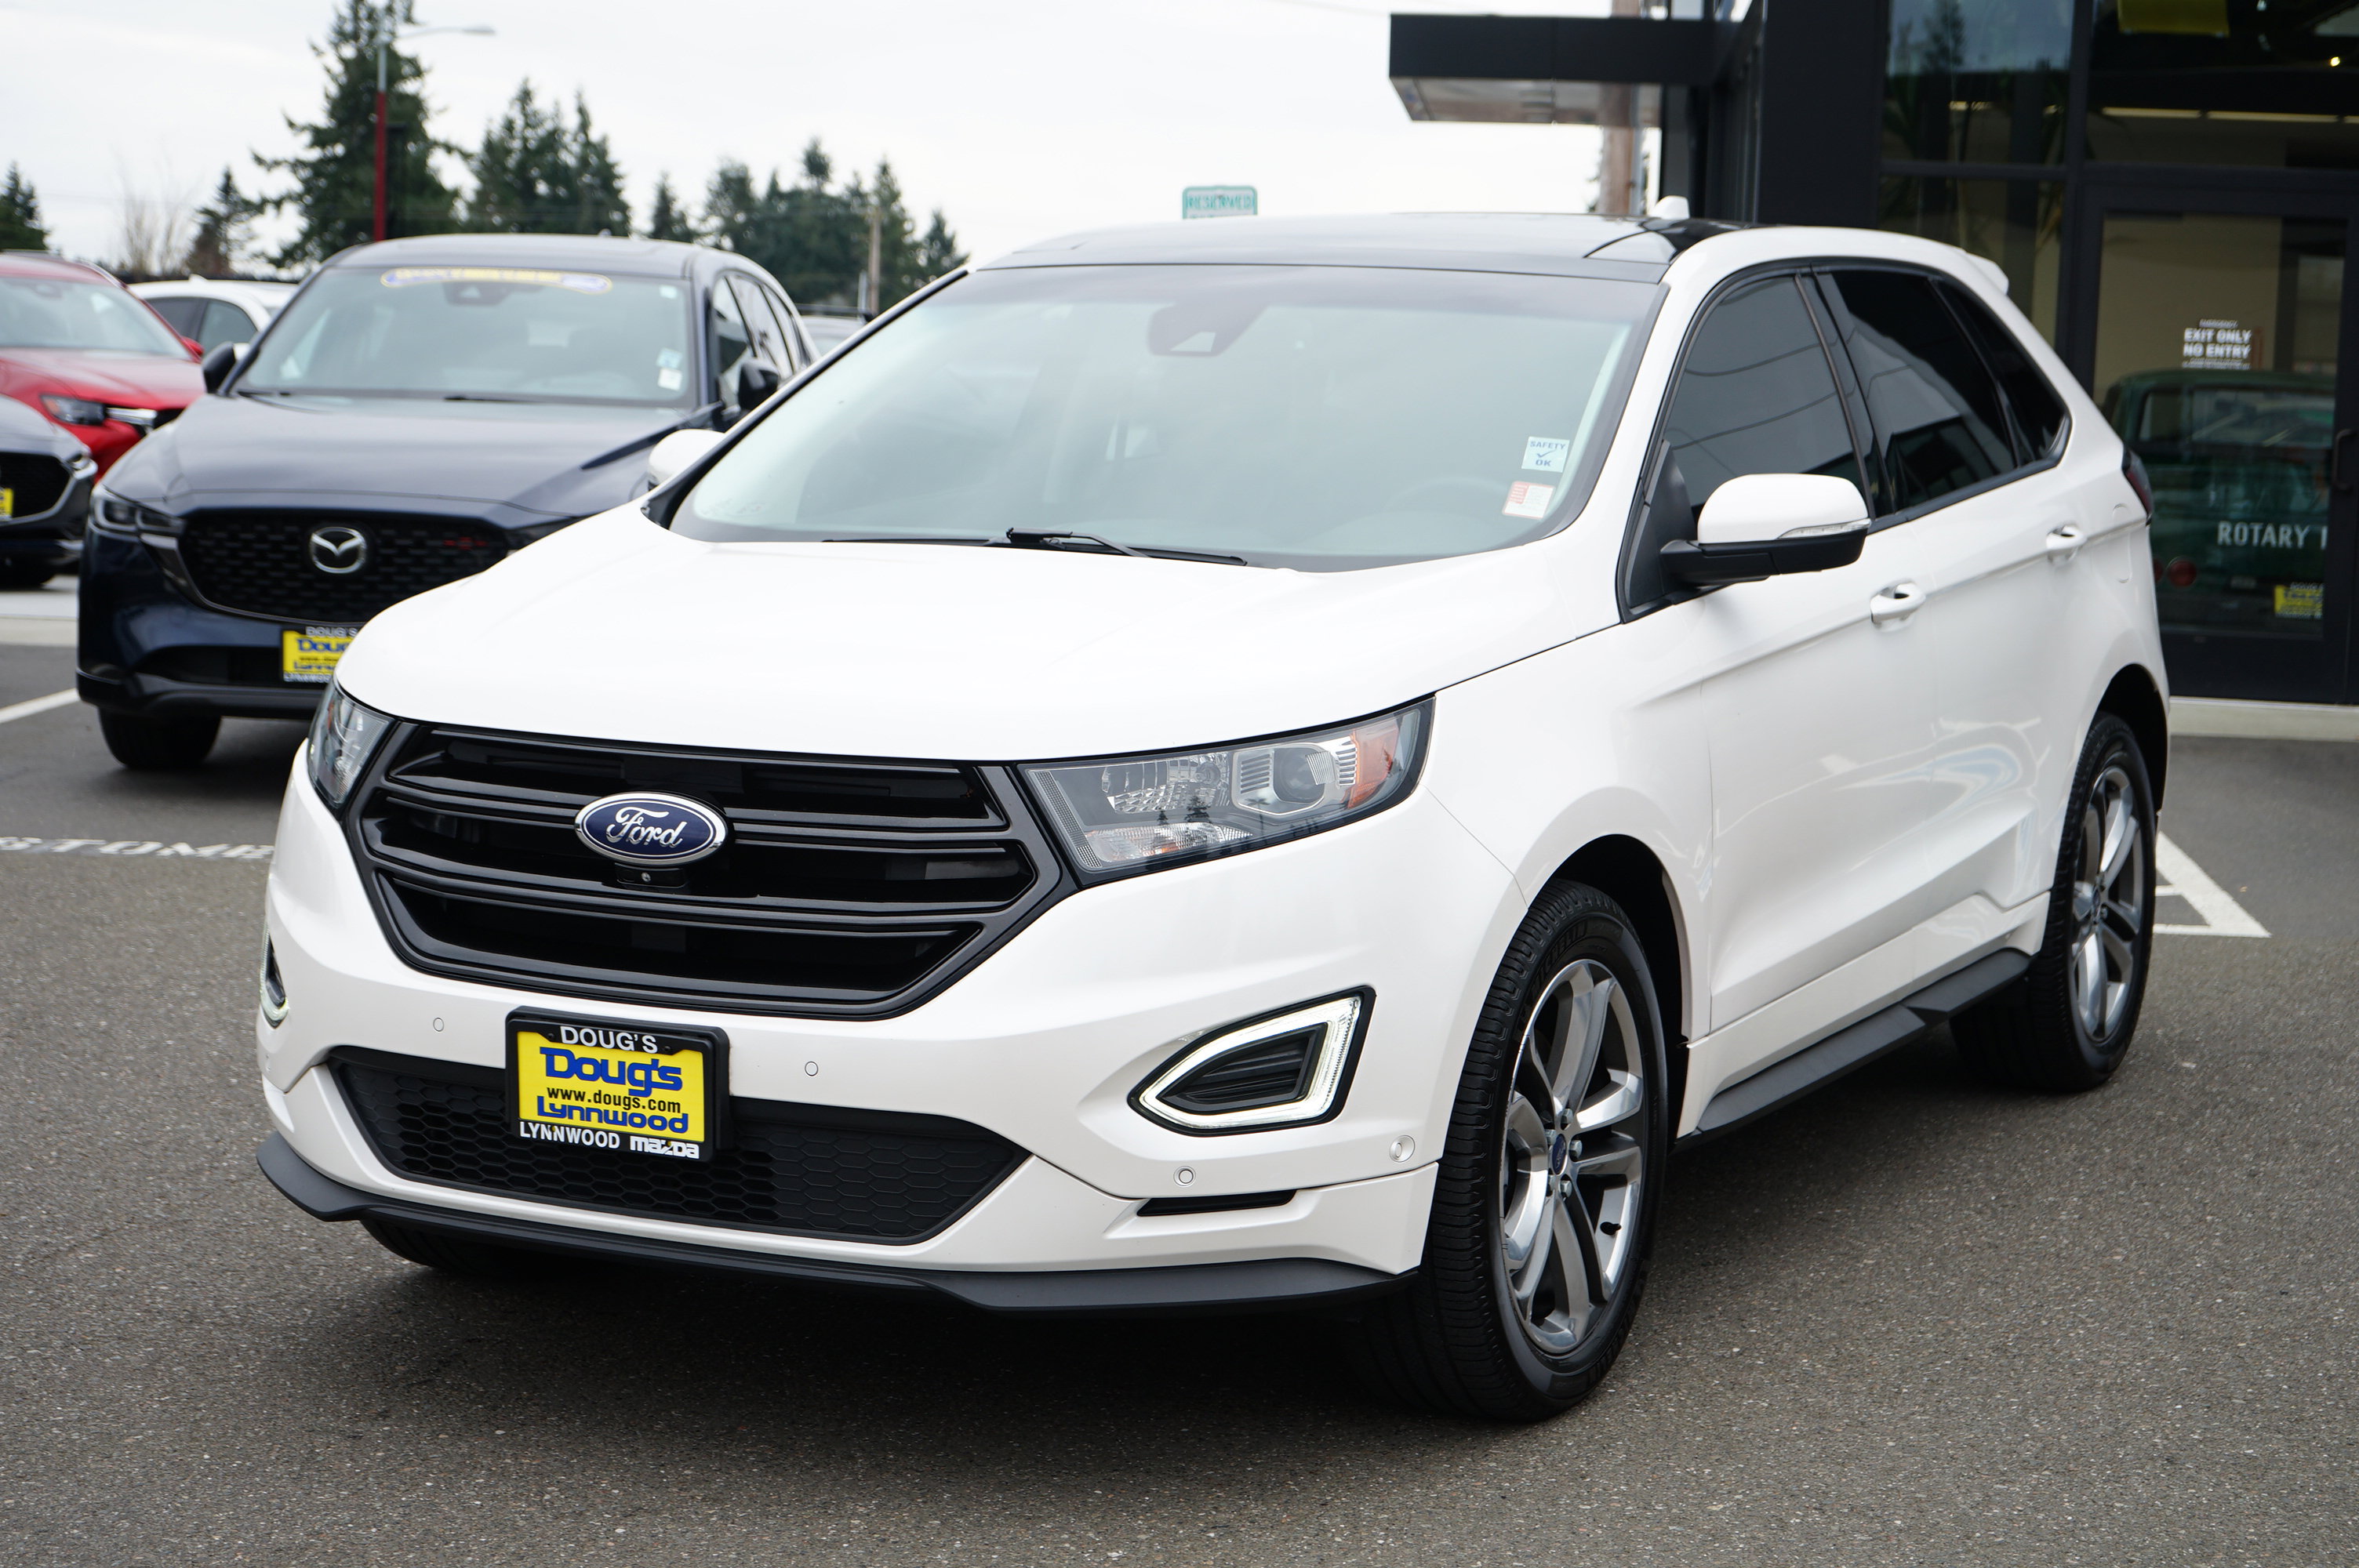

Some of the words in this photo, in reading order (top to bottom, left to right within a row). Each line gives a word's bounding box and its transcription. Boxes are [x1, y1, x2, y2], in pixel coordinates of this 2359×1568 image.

[2184, 328, 2215, 343] EXIT
[2216, 328, 2252, 344] ONLY
[2183, 343, 2205, 357] NO
[2205, 343, 2252, 358] ENTRY
[1530, 441, 1566, 450] SAFETY
[2217, 521, 2310, 549] ROTARY
[606, 806, 688, 848] Ford
[560, 1025, 659, 1054] DOUG'S
[540, 1047, 683, 1098] Doug's
[547, 1087, 682, 1113] www.dougs.com
[537, 1096, 689, 1134] Lynnwood
[520, 1121, 620, 1149] LYNNWOOD
